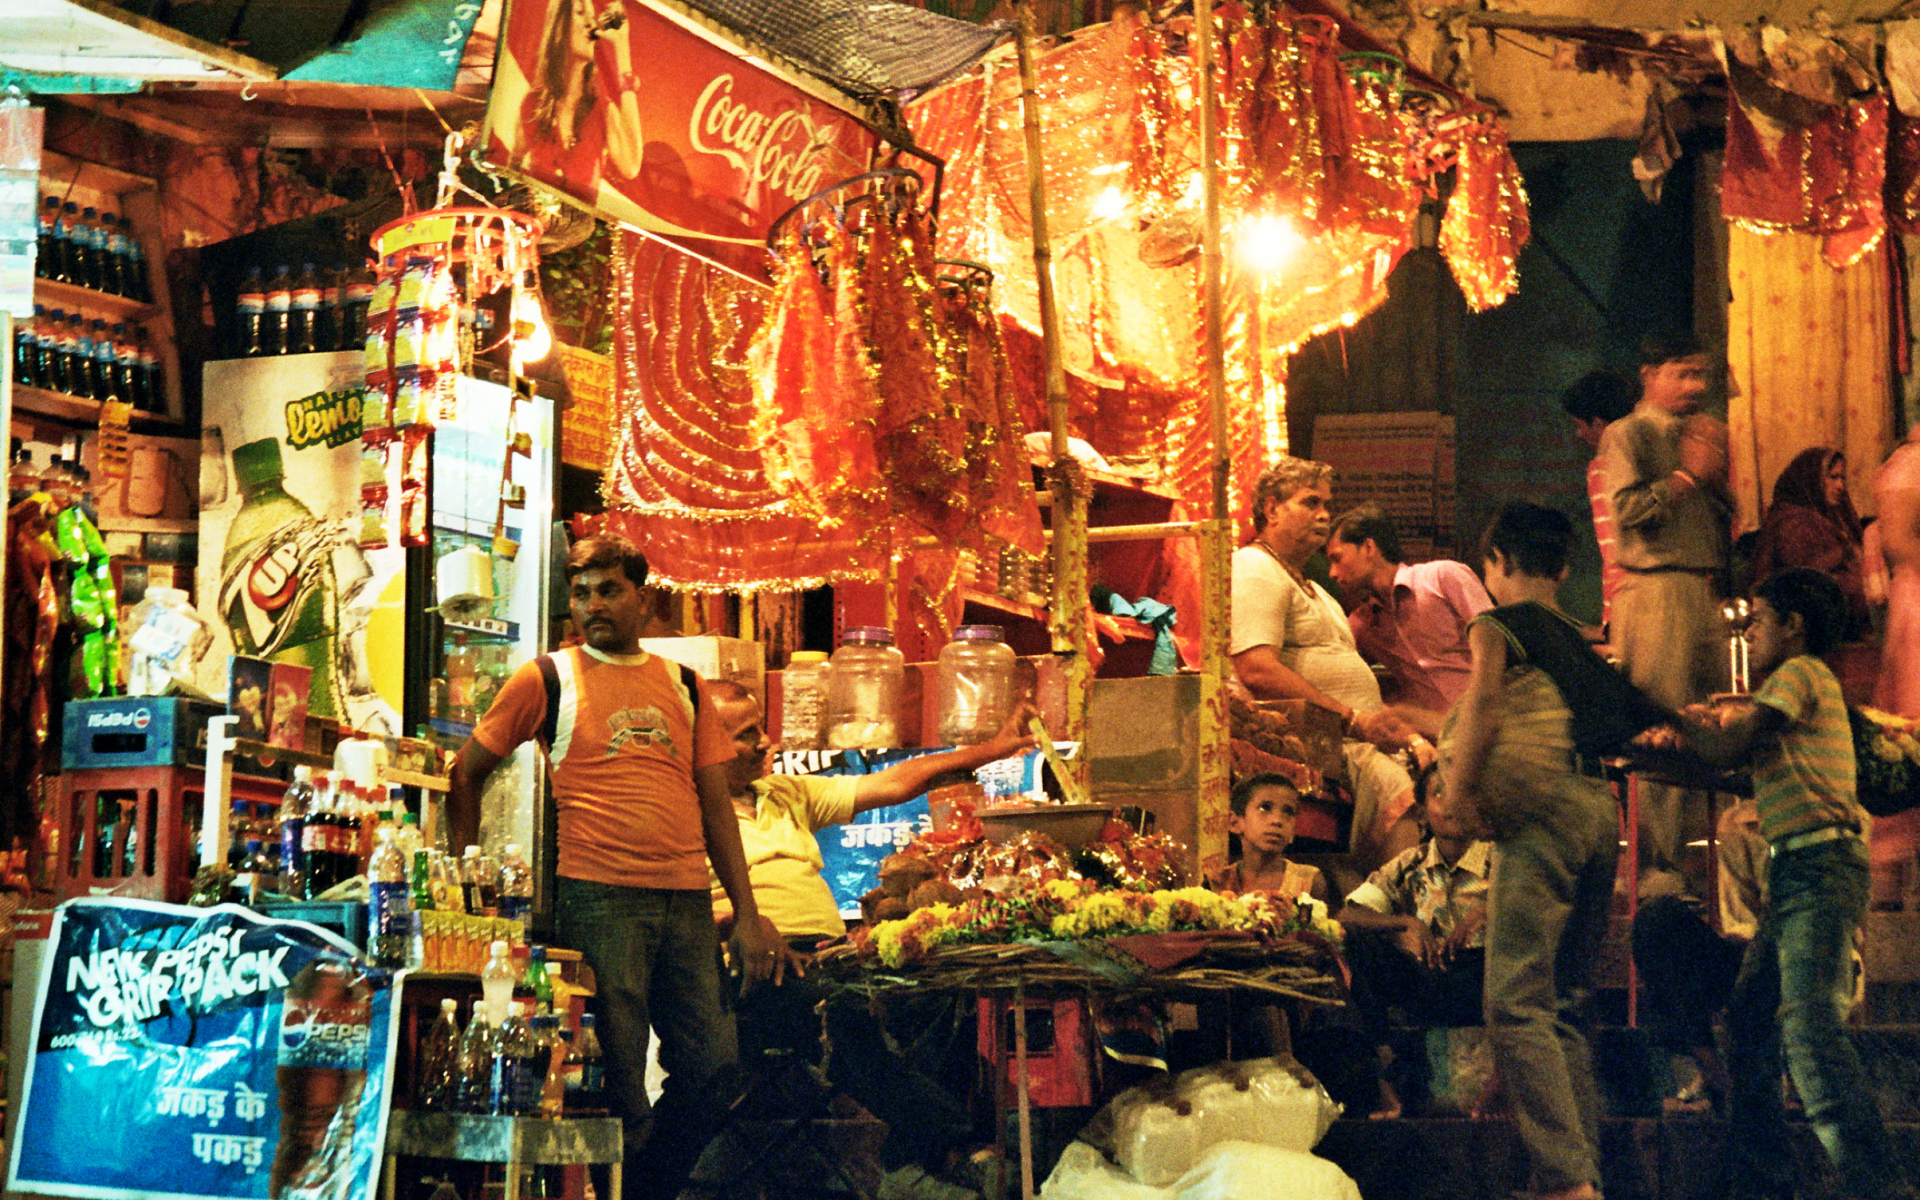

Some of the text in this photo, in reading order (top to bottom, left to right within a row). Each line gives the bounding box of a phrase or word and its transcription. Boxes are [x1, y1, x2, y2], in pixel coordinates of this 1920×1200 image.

[689, 73, 838, 202] Coca-Cola
[66, 926, 247, 992] NEW PEPSI
[86, 946, 291, 1027] GRIP PACK
[157, 1081, 268, 1127] जकड़ के
[192, 1133, 267, 1174] पकड़
